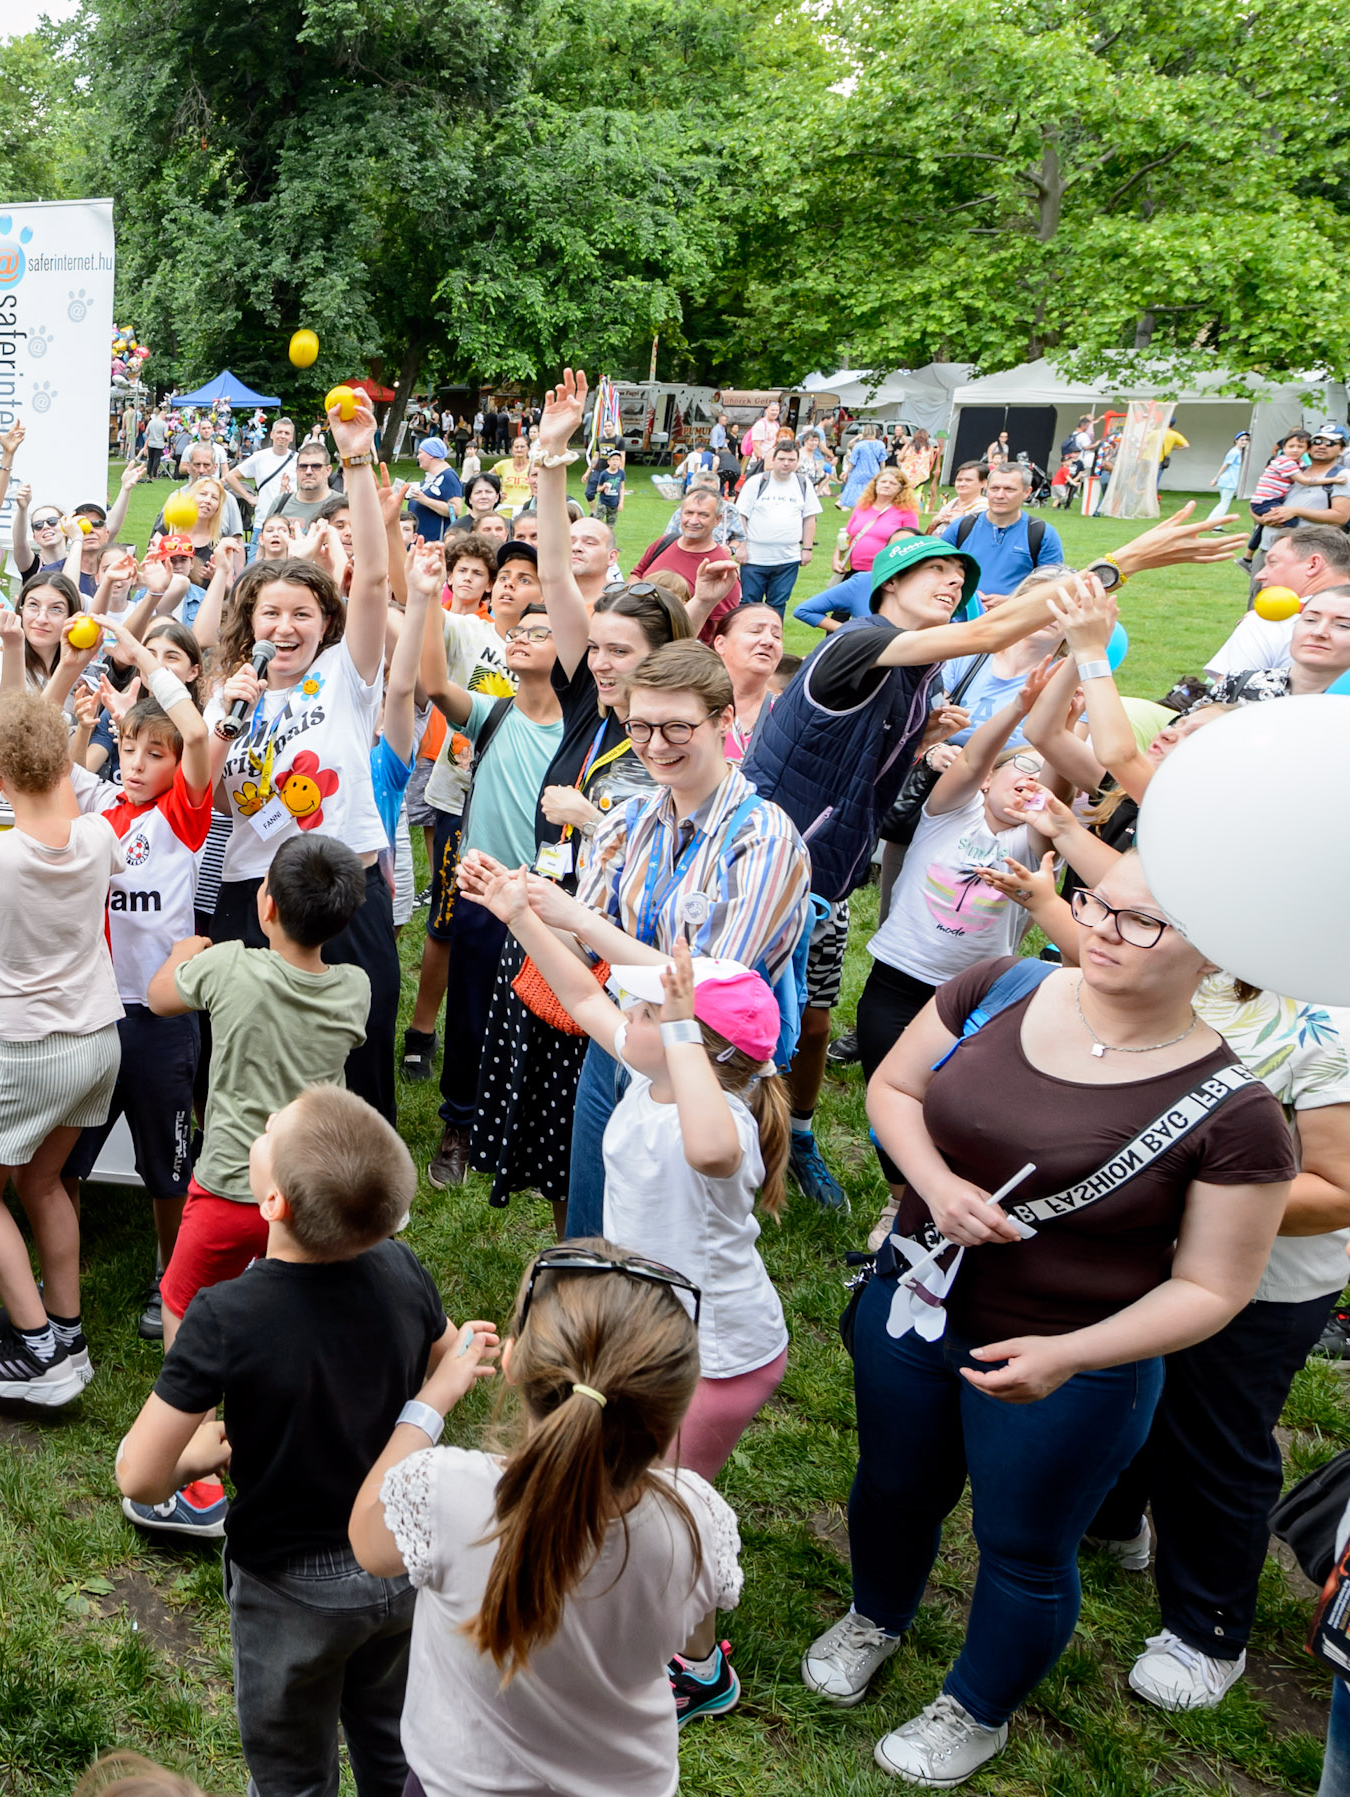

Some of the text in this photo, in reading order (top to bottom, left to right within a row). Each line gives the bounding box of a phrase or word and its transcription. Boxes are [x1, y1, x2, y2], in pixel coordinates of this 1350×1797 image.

[27, 250, 113, 272] saferinternet.hu
[262, 810, 282, 830] FANNI
[173, 1110, 186, 1173] ATHLETIC
